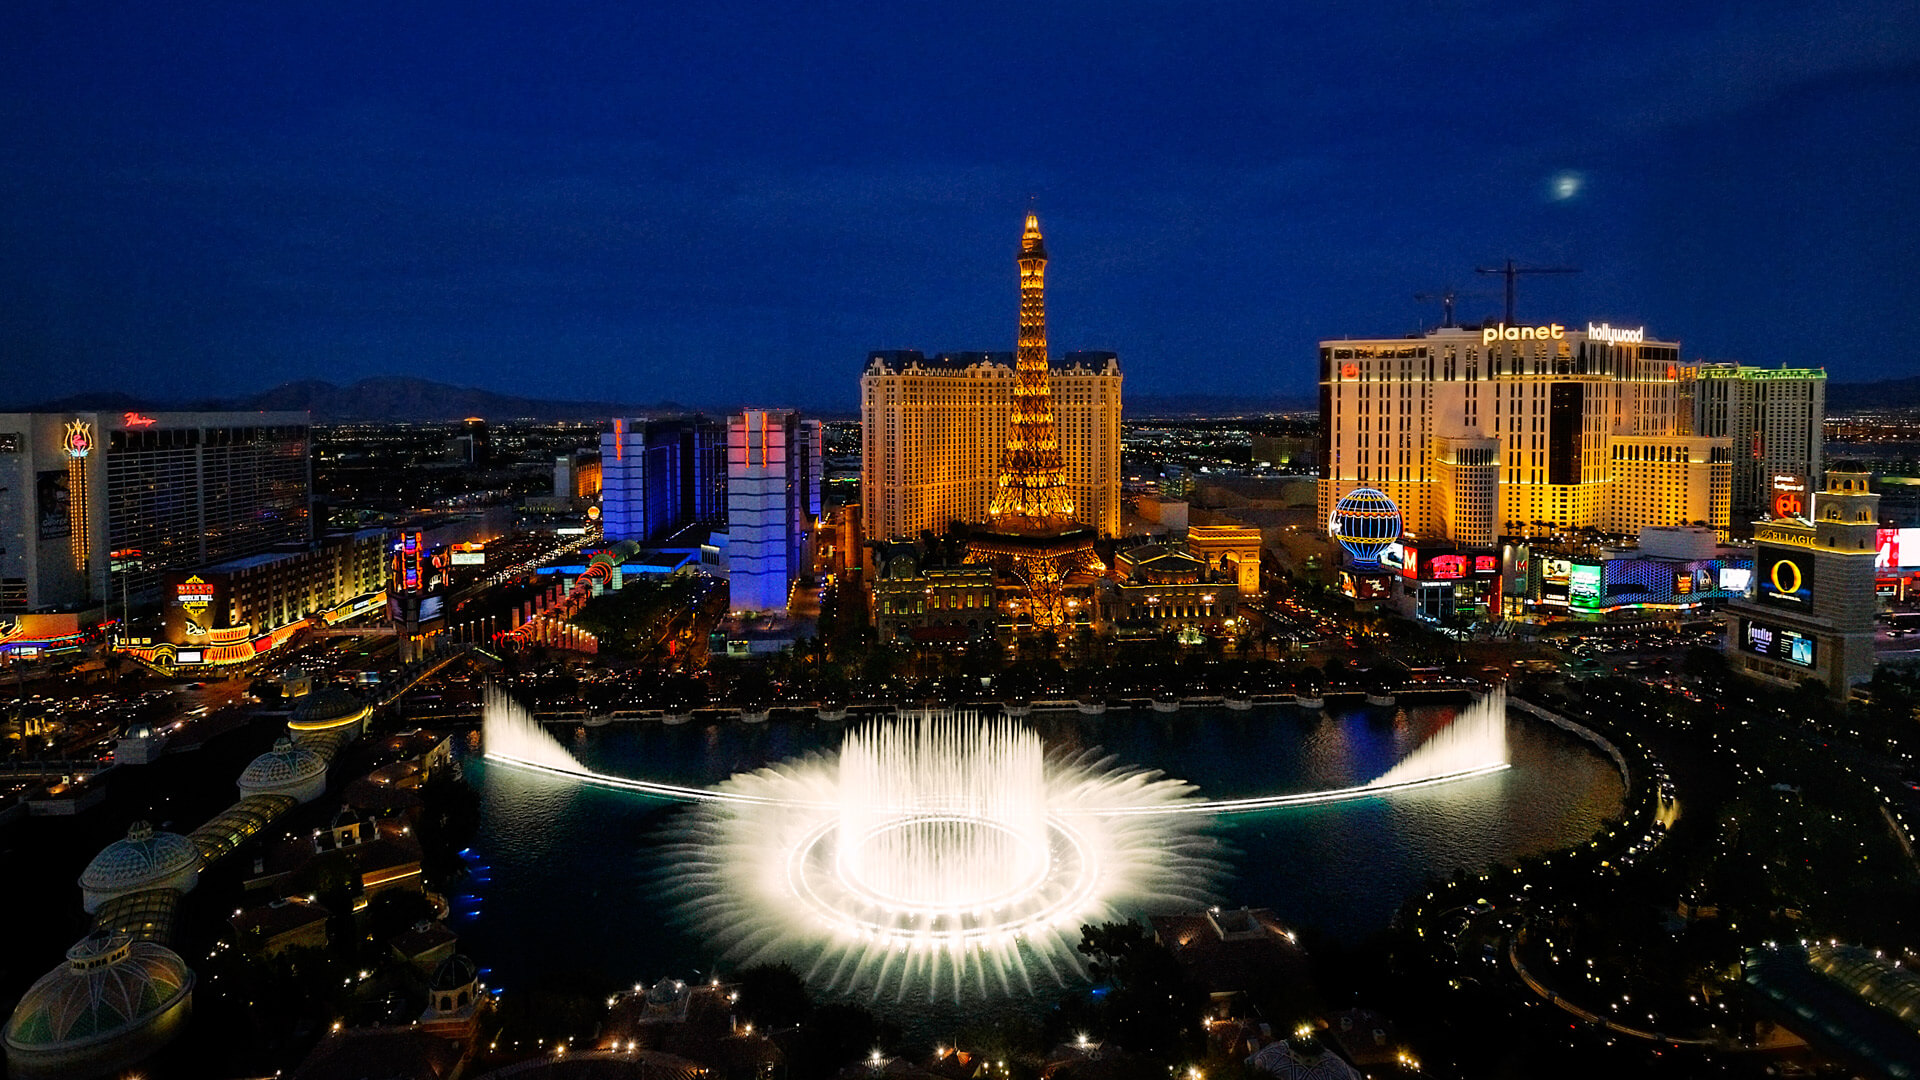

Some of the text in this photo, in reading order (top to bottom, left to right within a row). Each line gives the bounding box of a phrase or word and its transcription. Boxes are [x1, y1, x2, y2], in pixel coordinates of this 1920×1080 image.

[1483, 323, 1564, 345] planet
[1588, 322, 1644, 347] hollywood
[1404, 549, 1417, 572] M
[1770, 560, 1802, 594] O
